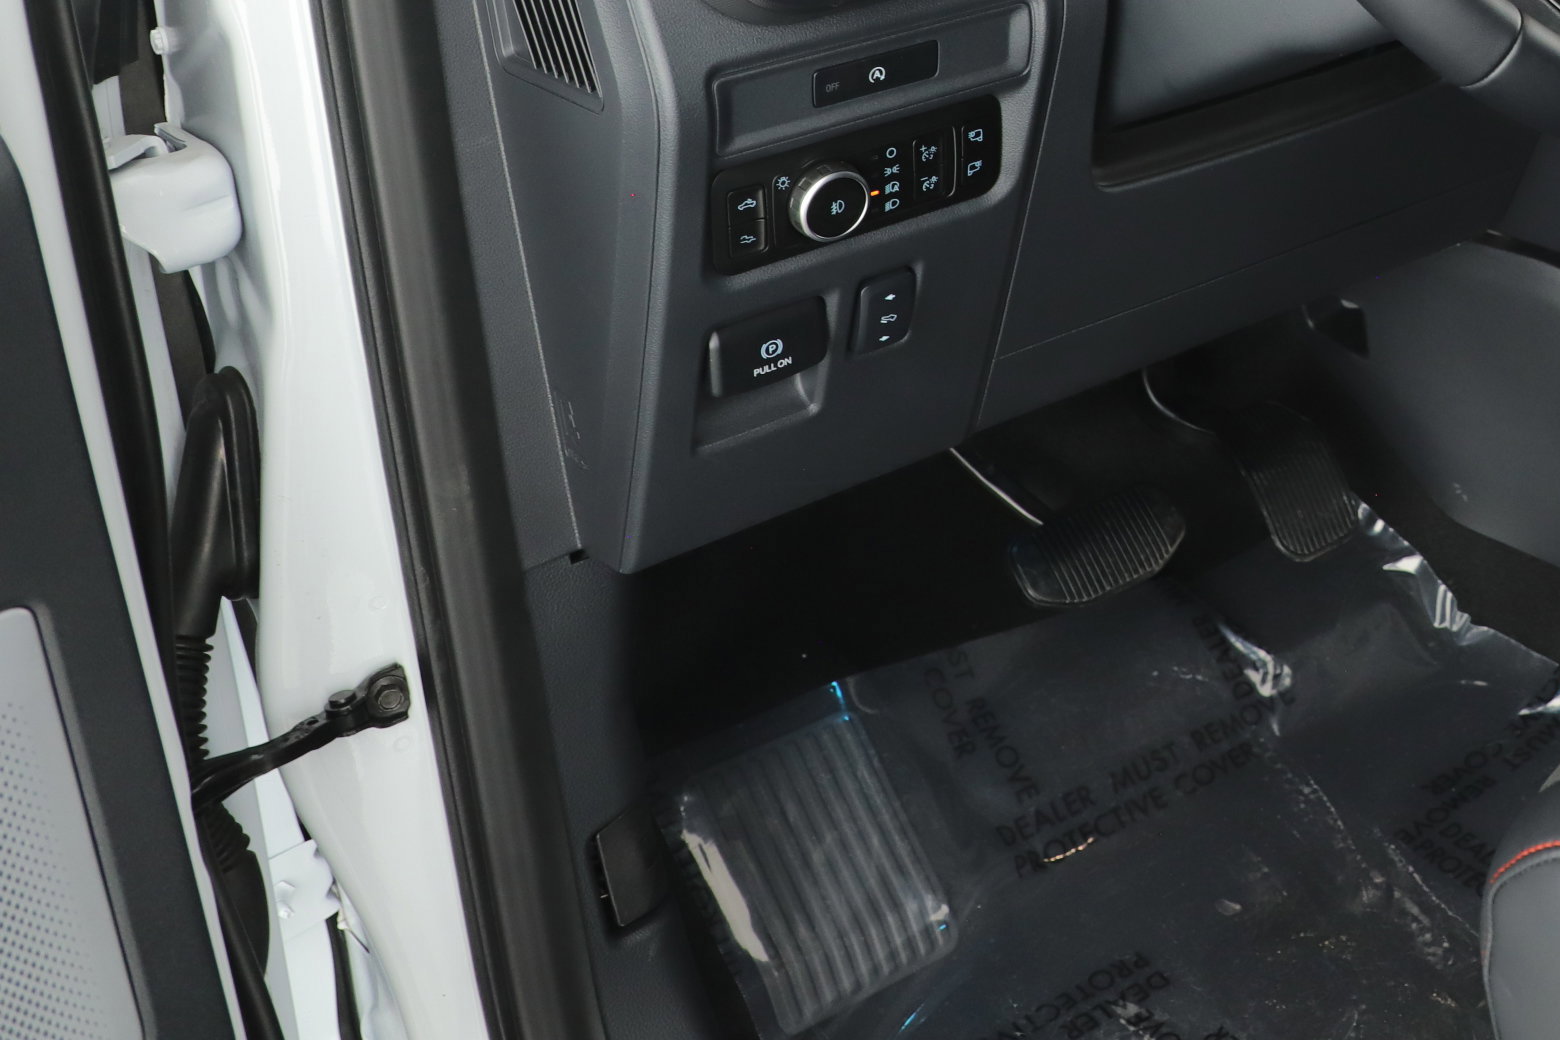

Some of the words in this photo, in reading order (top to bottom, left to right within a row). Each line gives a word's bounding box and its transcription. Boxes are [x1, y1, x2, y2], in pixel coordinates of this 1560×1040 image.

[825, 81, 841, 93] OFF
[753, 363, 778, 377] PULL
[777, 356, 793, 368] ON
[923, 667, 978, 761] COVER
[965, 695, 1040, 804] REMOVE
[994, 784, 1096, 848] DEALER
[1108, 739, 1180, 794] MUST
[1012, 785, 1170, 880] PROTECTIVE
[1172, 740, 1262, 796] COVER
